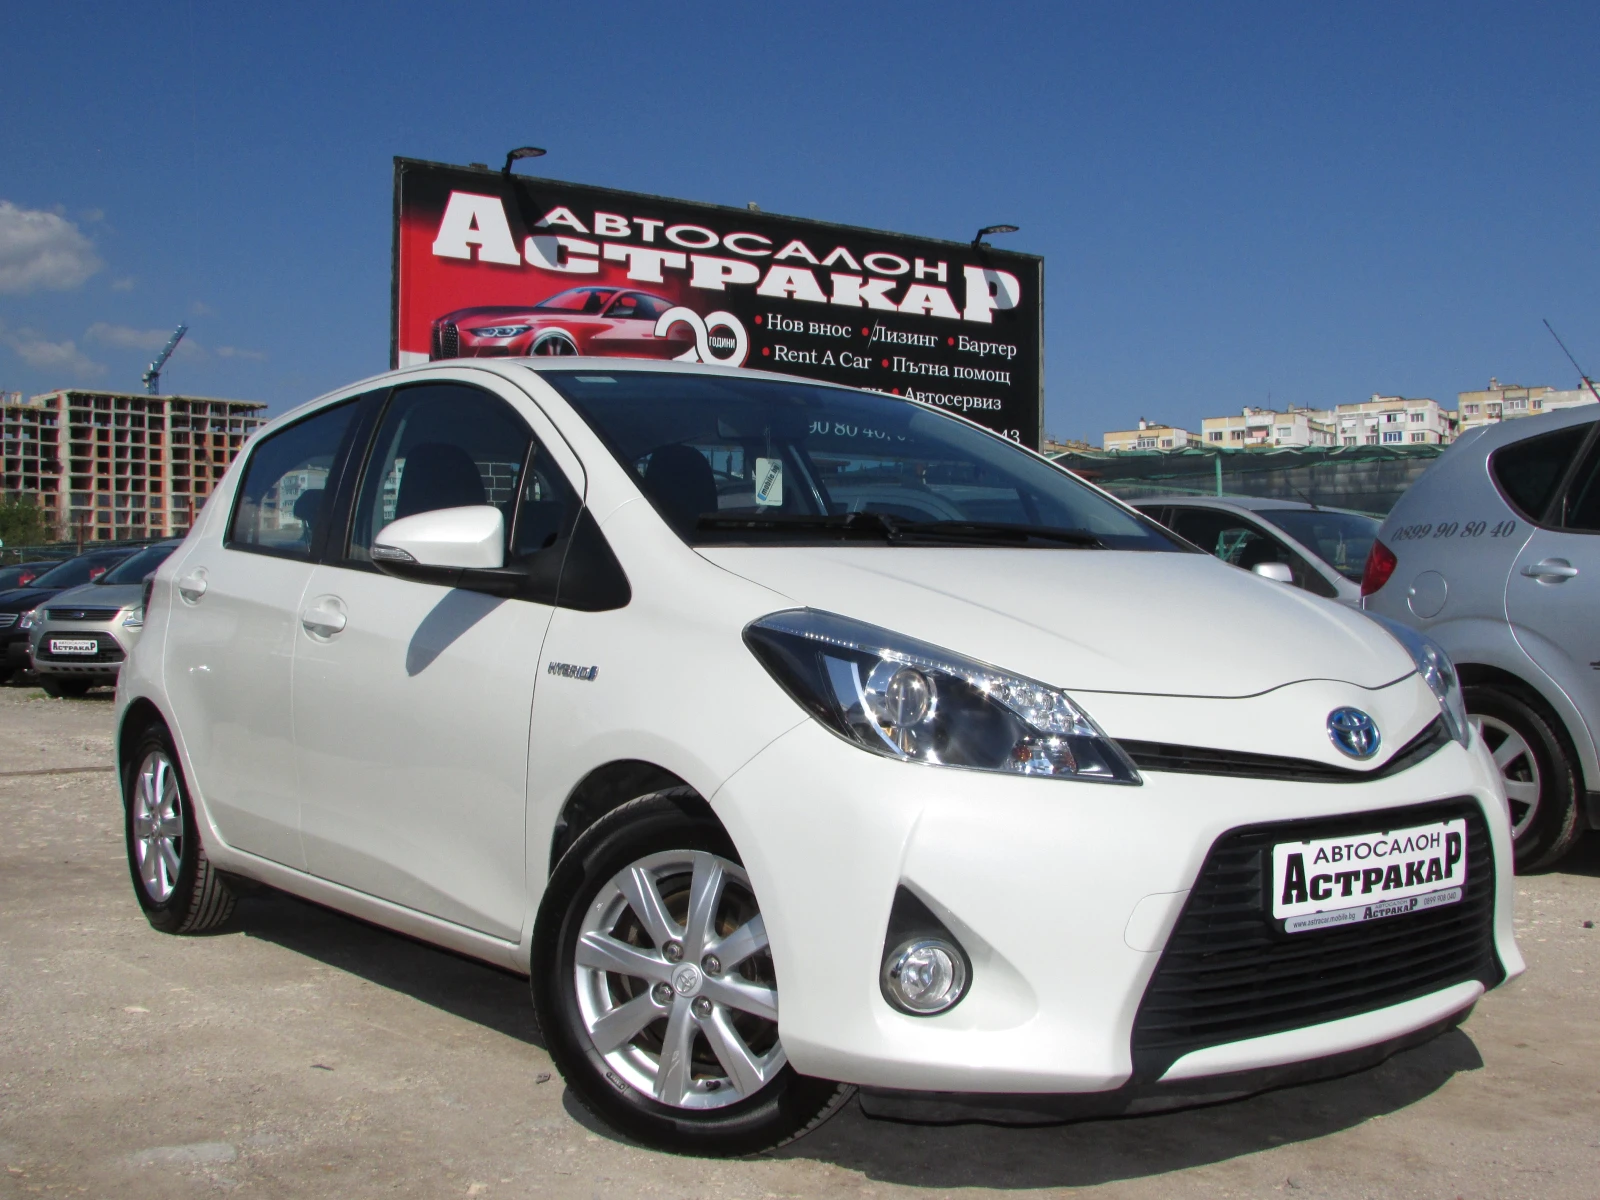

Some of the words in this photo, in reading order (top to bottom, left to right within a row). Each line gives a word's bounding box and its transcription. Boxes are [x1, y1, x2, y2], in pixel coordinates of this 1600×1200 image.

[432, 189, 1020, 324] АСТРАКАР
[533, 206, 948, 282] АВТОСАЛОН
[709, 336, 736, 349] ГОДИНИ
[766, 313, 804, 333] Нов
[808, 319, 852, 338] внос
[872, 325, 939, 348] Лизинг
[957, 335, 1017, 360] Бартер
[773, 344, 818, 365] Rent
[839, 351, 872, 370] Car
[892, 356, 950, 378] Пътна
[952, 366, 1011, 386] помощ
[904, 387, 1002, 412] Автосервиз
[1390, 523, 1432, 542] 0899
[1433, 522, 1459, 540] 90
[1460, 521, 1486, 538] 80
[1490, 519, 1516, 538] 40
[1313, 832, 1440, 865] АВТОСАЛОН
[1281, 831, 1462, 905] АСТРАКАР
[1293, 911, 1356, 929] www.astracar.mobile.bg
[1363, 898, 1417, 920] АСТРАКАР
